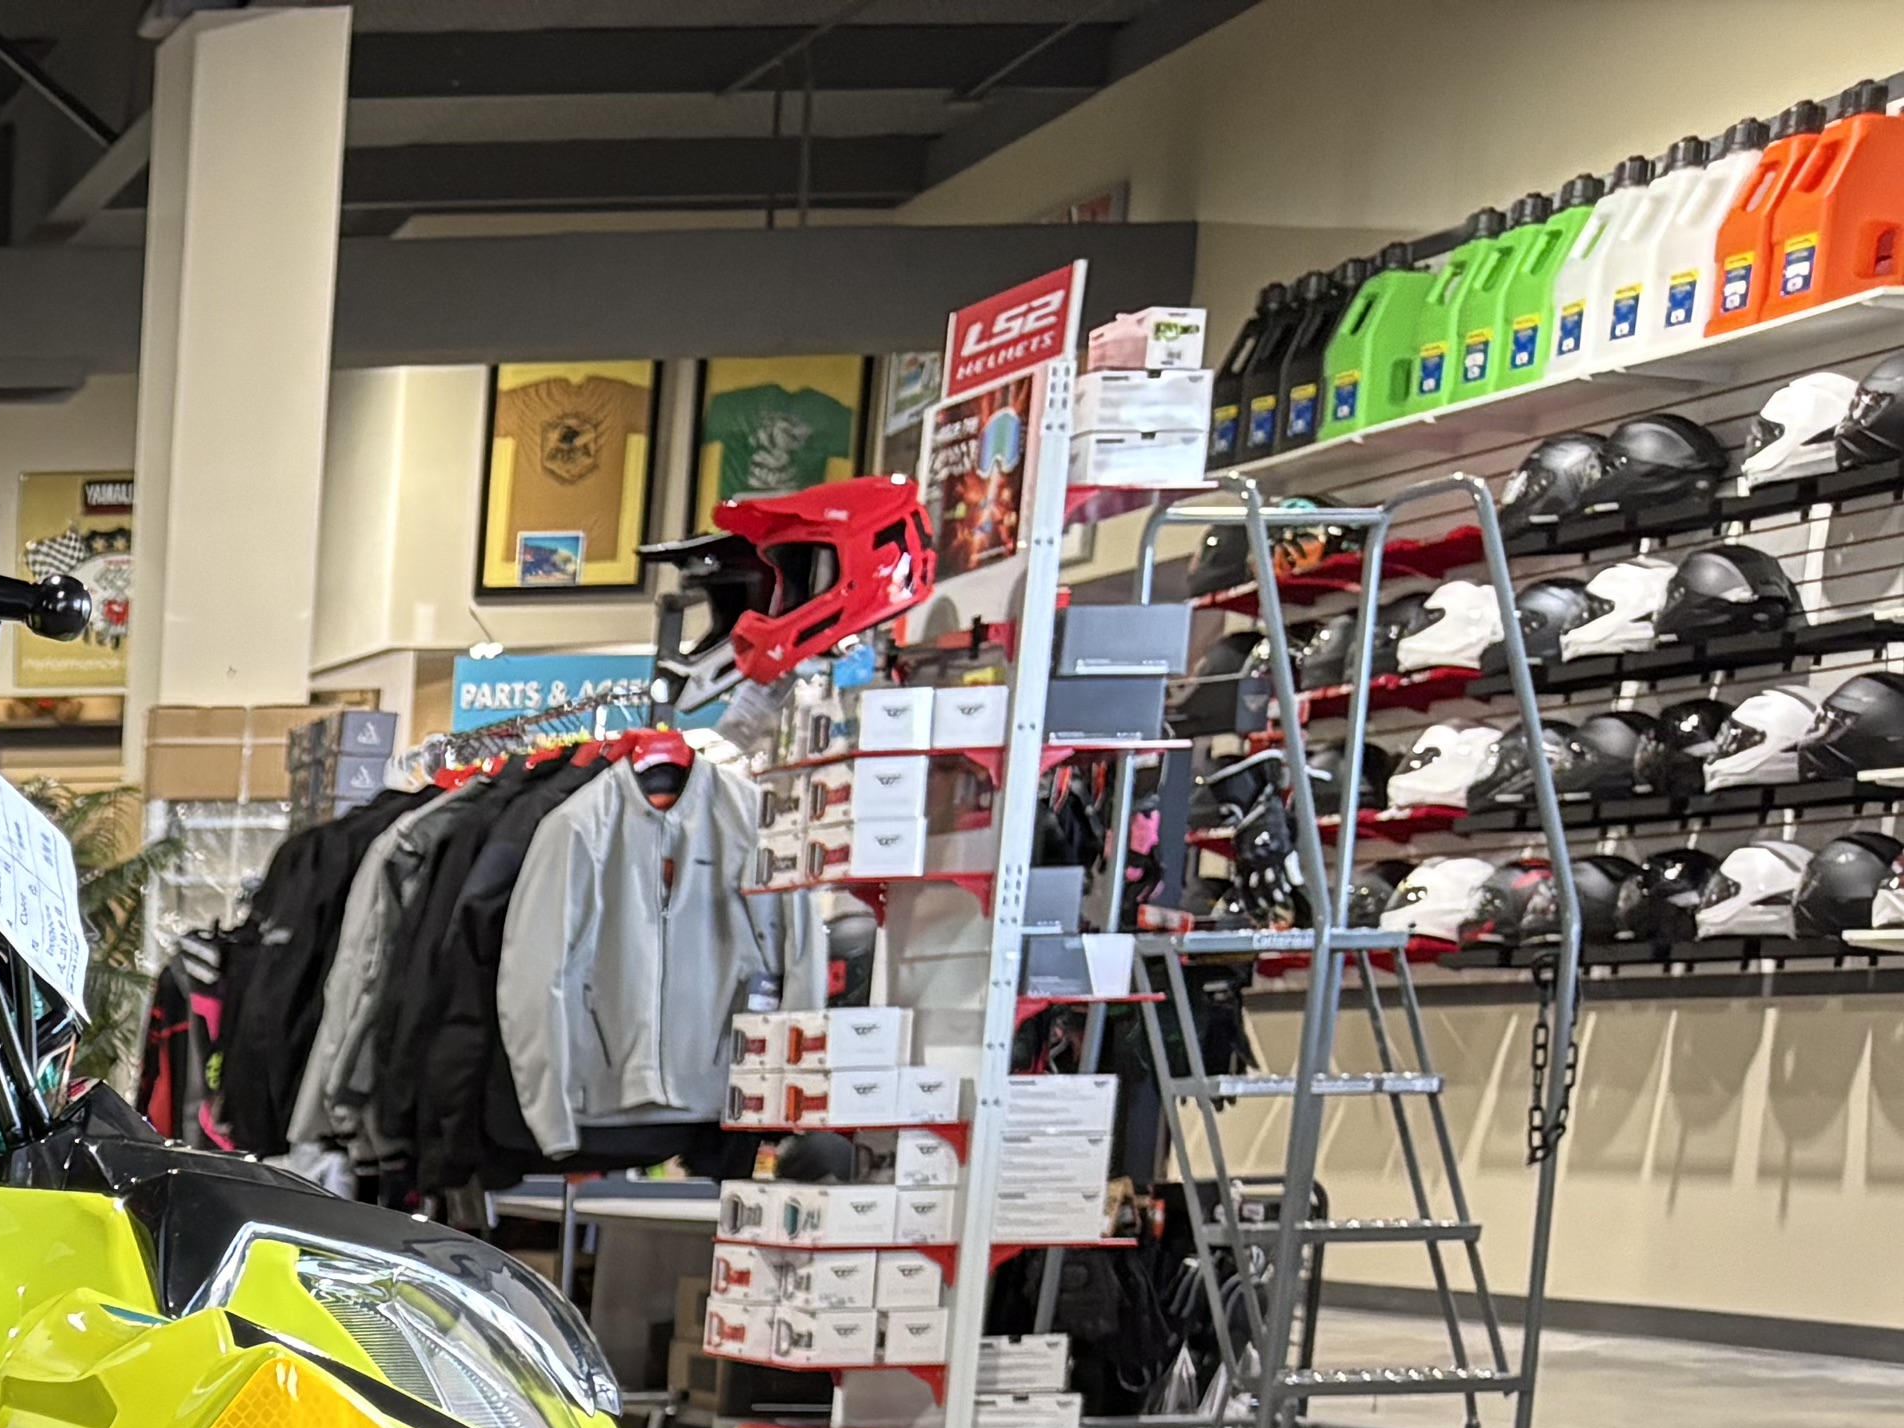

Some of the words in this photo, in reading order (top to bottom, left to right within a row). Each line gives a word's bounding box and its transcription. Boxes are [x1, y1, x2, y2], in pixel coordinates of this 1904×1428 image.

[960, 289, 1065, 358] LS2
[956, 331, 1056, 380] HELMETS
[460, 681, 540, 709] PARTS
[548, 680, 566, 705] &
